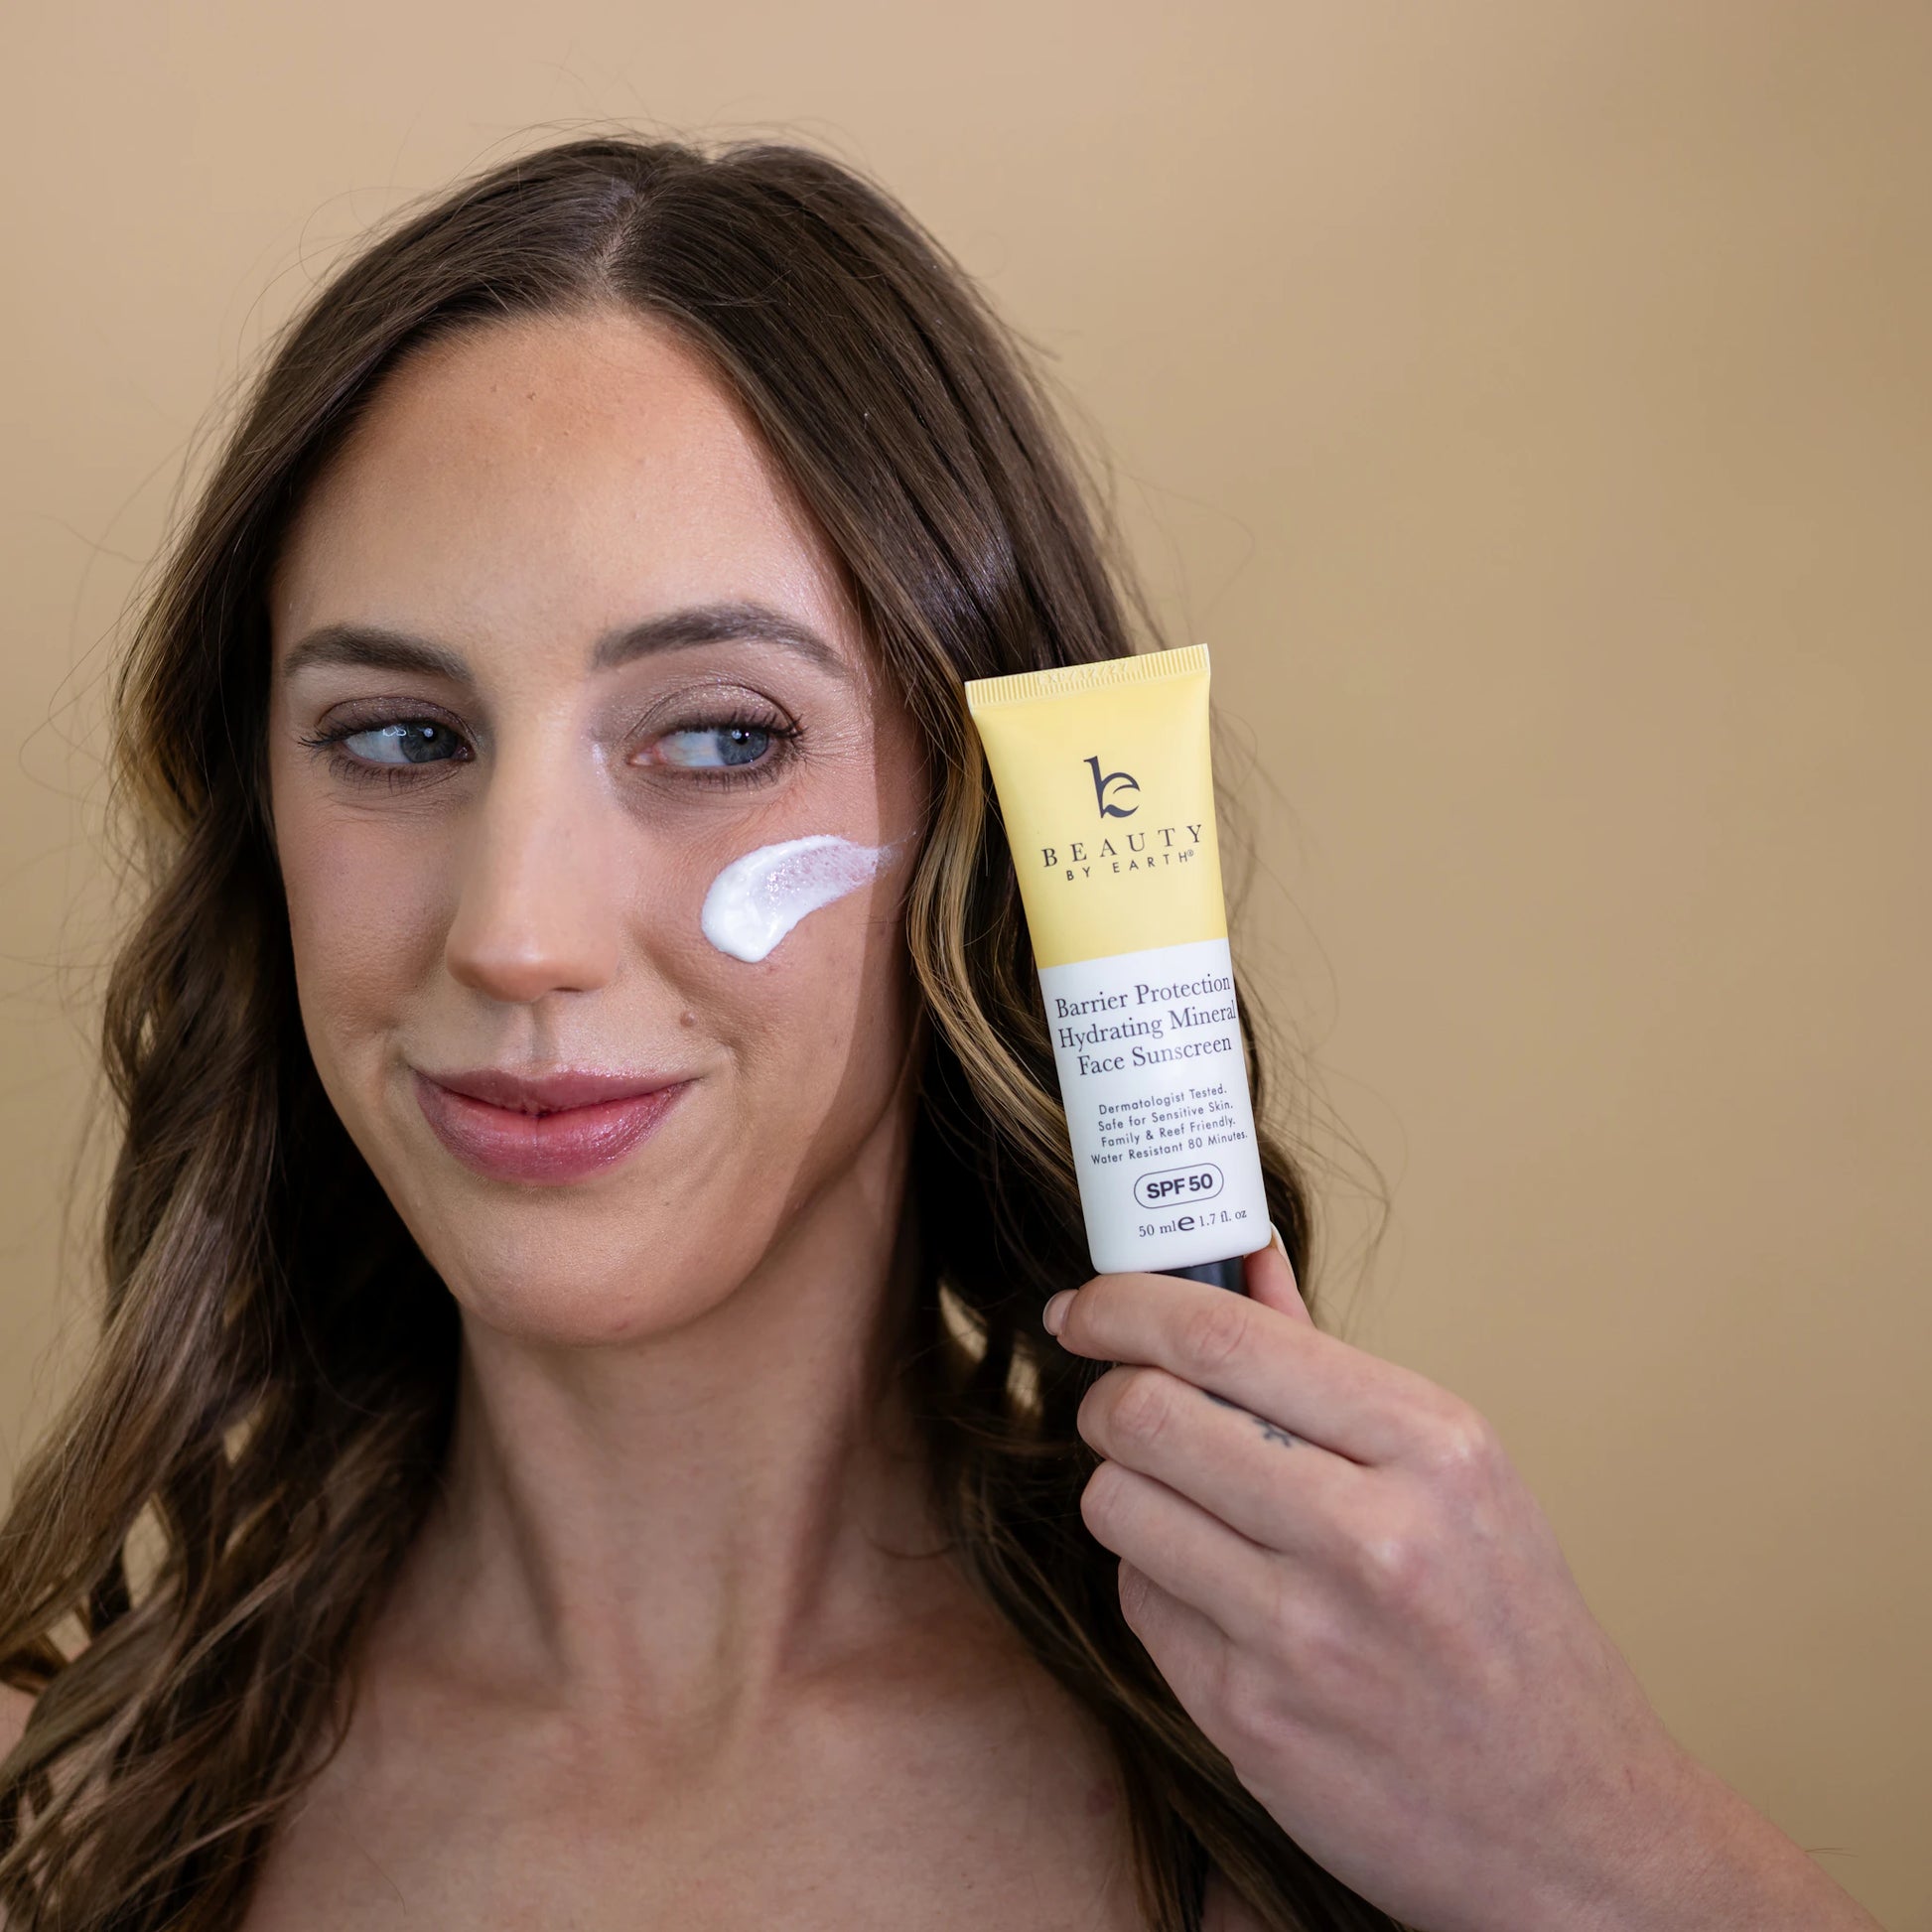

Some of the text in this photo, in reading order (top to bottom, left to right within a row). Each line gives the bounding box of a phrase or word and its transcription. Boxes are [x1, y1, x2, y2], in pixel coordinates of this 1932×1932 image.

[1041, 824, 1201, 867] BEAUTY
[1066, 867, 1090, 881] BY
[1054, 973, 1230, 1019] Barrier Protection
[1058, 1000, 1236, 1052] Hydrating Mineral
[1077, 1037, 1232, 1075] Face Sunscreen
[1099, 1083, 1227, 1115] Dermatologist Tested.
[1098, 1100, 1233, 1132] Safe for Sensitive Skin.
[1101, 1115, 1235, 1147] Family & Reef Friendly.
[1091, 1132, 1247, 1165] Water Resistant 80 Minutes.
[1147, 1173, 1213, 1199] SPF 50
[1139, 1224, 1155, 1237] 50
[1199, 1213, 1215, 1227] 1.7
[1235, 1210, 1247, 1219] oz
